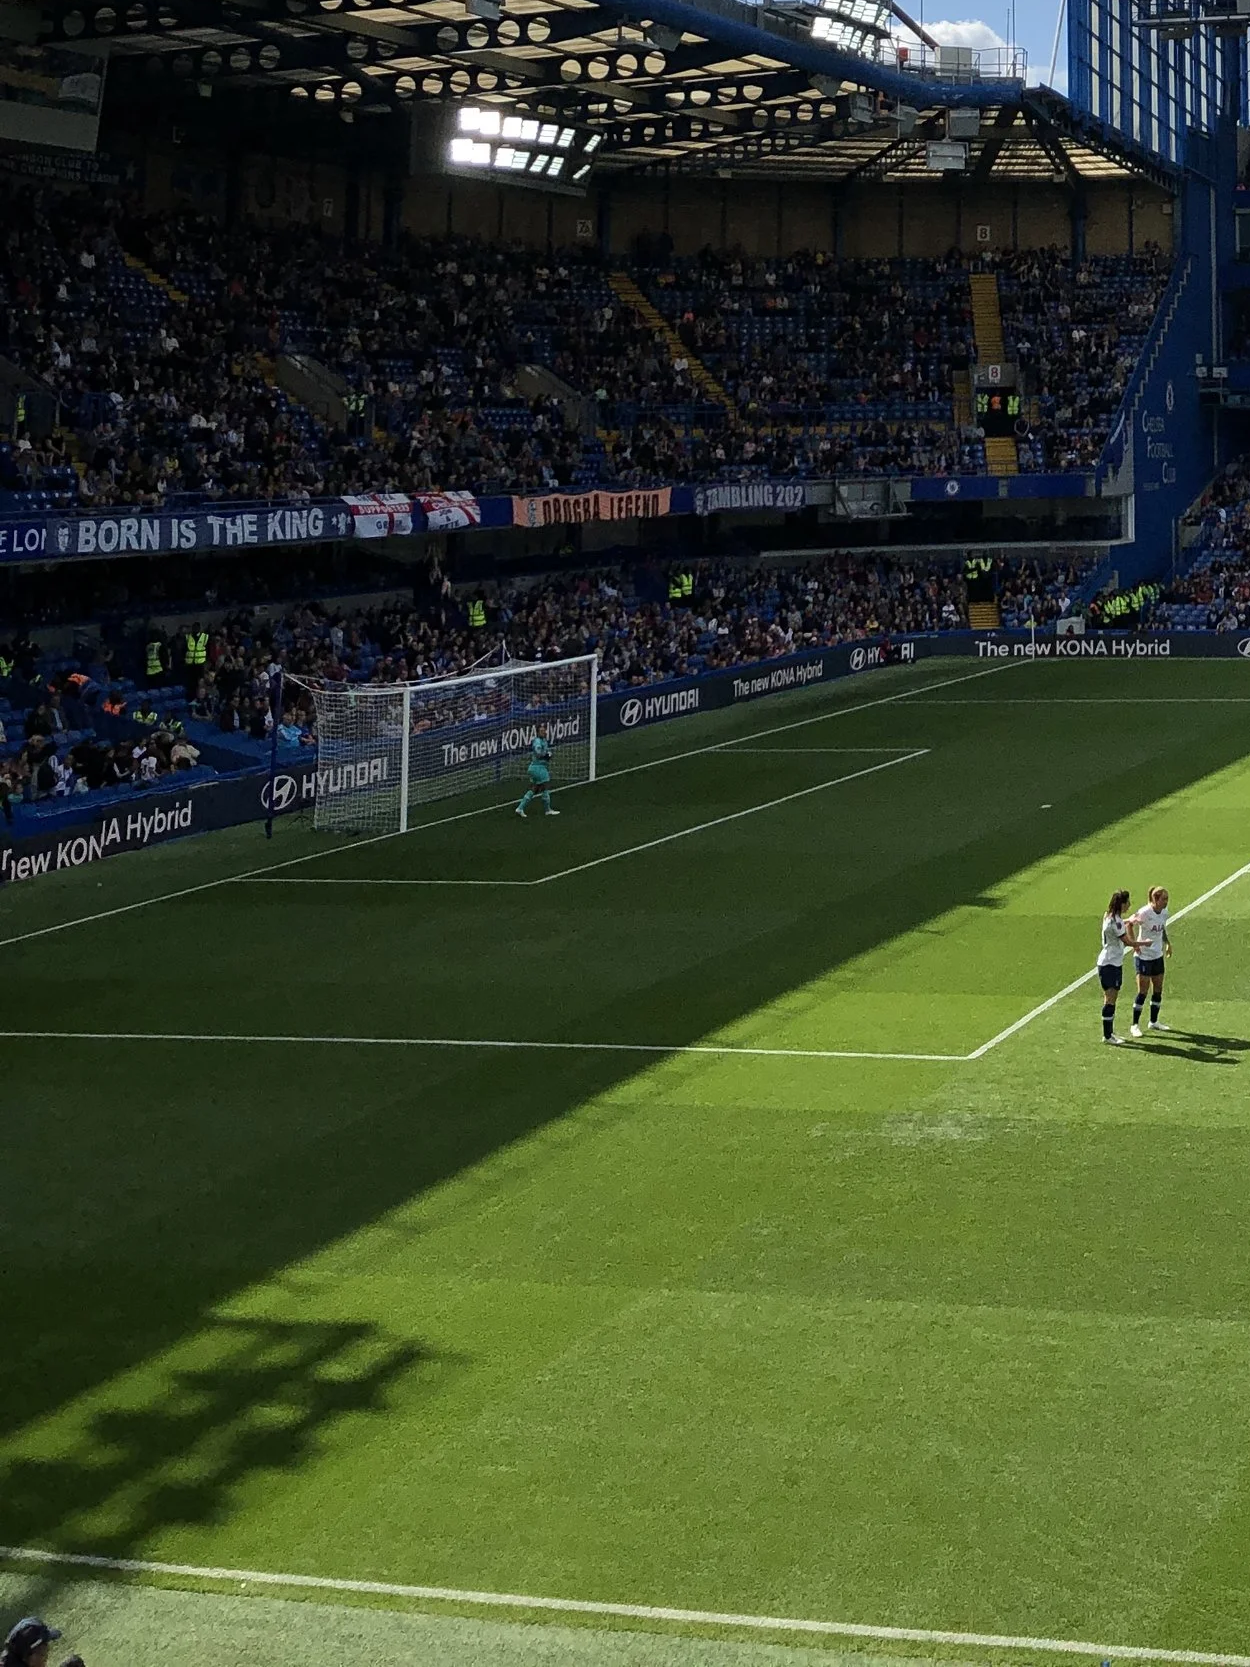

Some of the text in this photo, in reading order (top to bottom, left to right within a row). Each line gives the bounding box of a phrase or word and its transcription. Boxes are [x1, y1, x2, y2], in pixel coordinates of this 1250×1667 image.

[609, 493, 660, 520] LEGEND
[776, 485, 803, 507] 202
[78, 507, 324, 554] BORN IS THE KING
[868, 642, 914, 665] HYAI
[975, 638, 1171, 658] The new KONA Hybrid
[733, 659, 823, 697] The new KONA Hybrid
[645, 687, 700, 719] HYUNDAI
[442, 742, 468, 767] The
[471, 737, 498, 759] new
[501, 724, 537, 753] KONA
[302, 757, 388, 799] HYUNDAI
[57, 818, 121, 870] KONA
[126, 799, 192, 843] Hybrid
